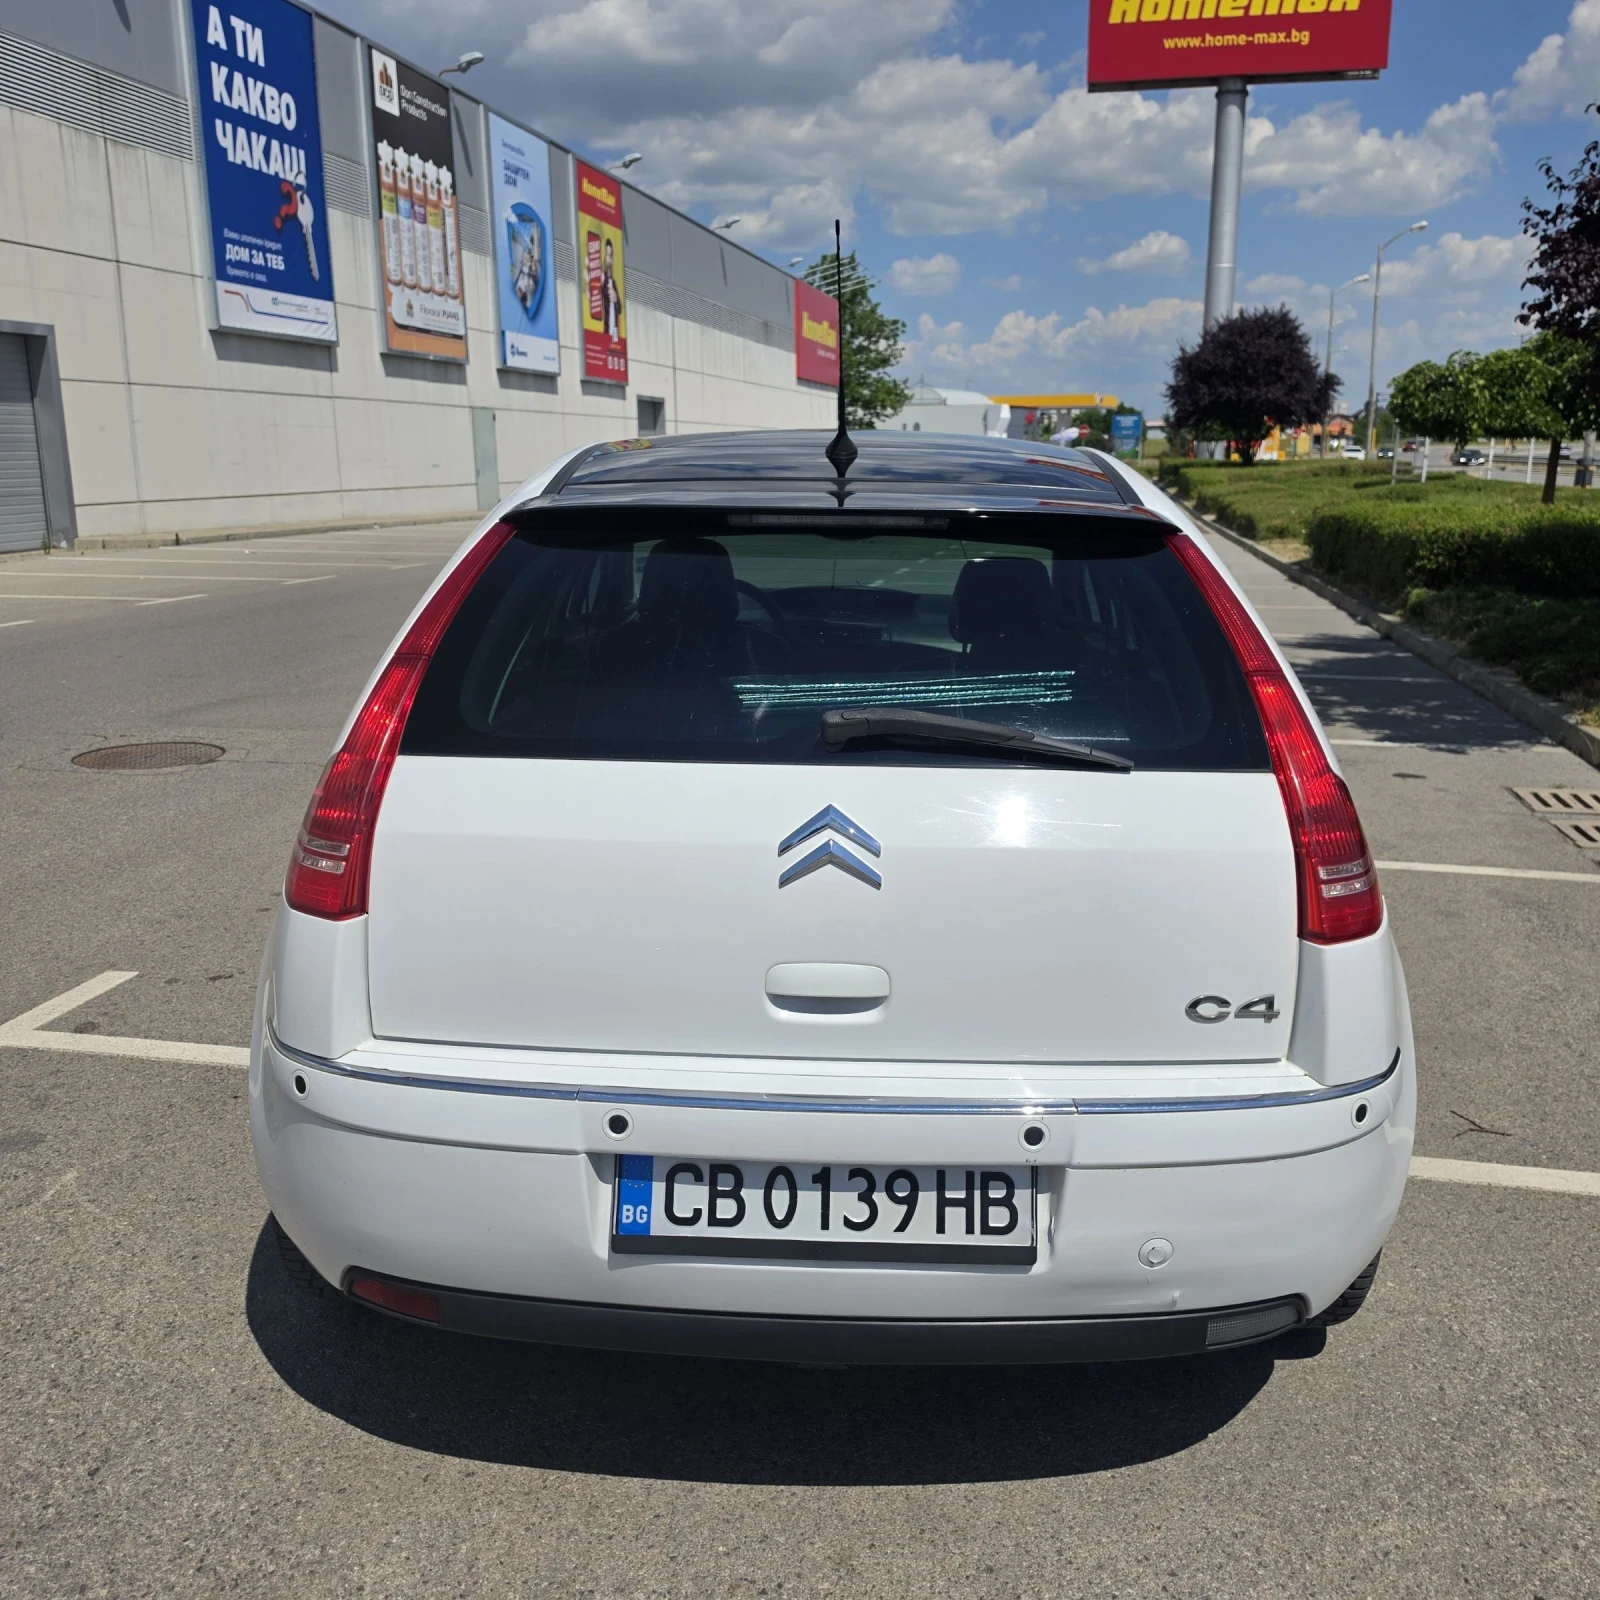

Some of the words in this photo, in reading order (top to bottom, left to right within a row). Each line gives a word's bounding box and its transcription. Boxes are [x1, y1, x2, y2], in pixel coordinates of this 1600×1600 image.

[207, 5, 227, 50] А
[230, 15, 265, 67] ТИ
[1163, 28, 1310, 49] www.home-max.bg
[210, 61, 297, 131] КАКВО
[225, 243, 250, 262] ДОМ
[251, 250, 265, 267] ЗА
[266, 253, 285, 271] ТЕБ
[1185, 993, 1280, 1024] C4
[622, 1205, 648, 1224] BG
[664, 1163, 746, 1228] CB
[764, 1166, 920, 1233] 0139
[936, 1170, 1018, 1235] HB
